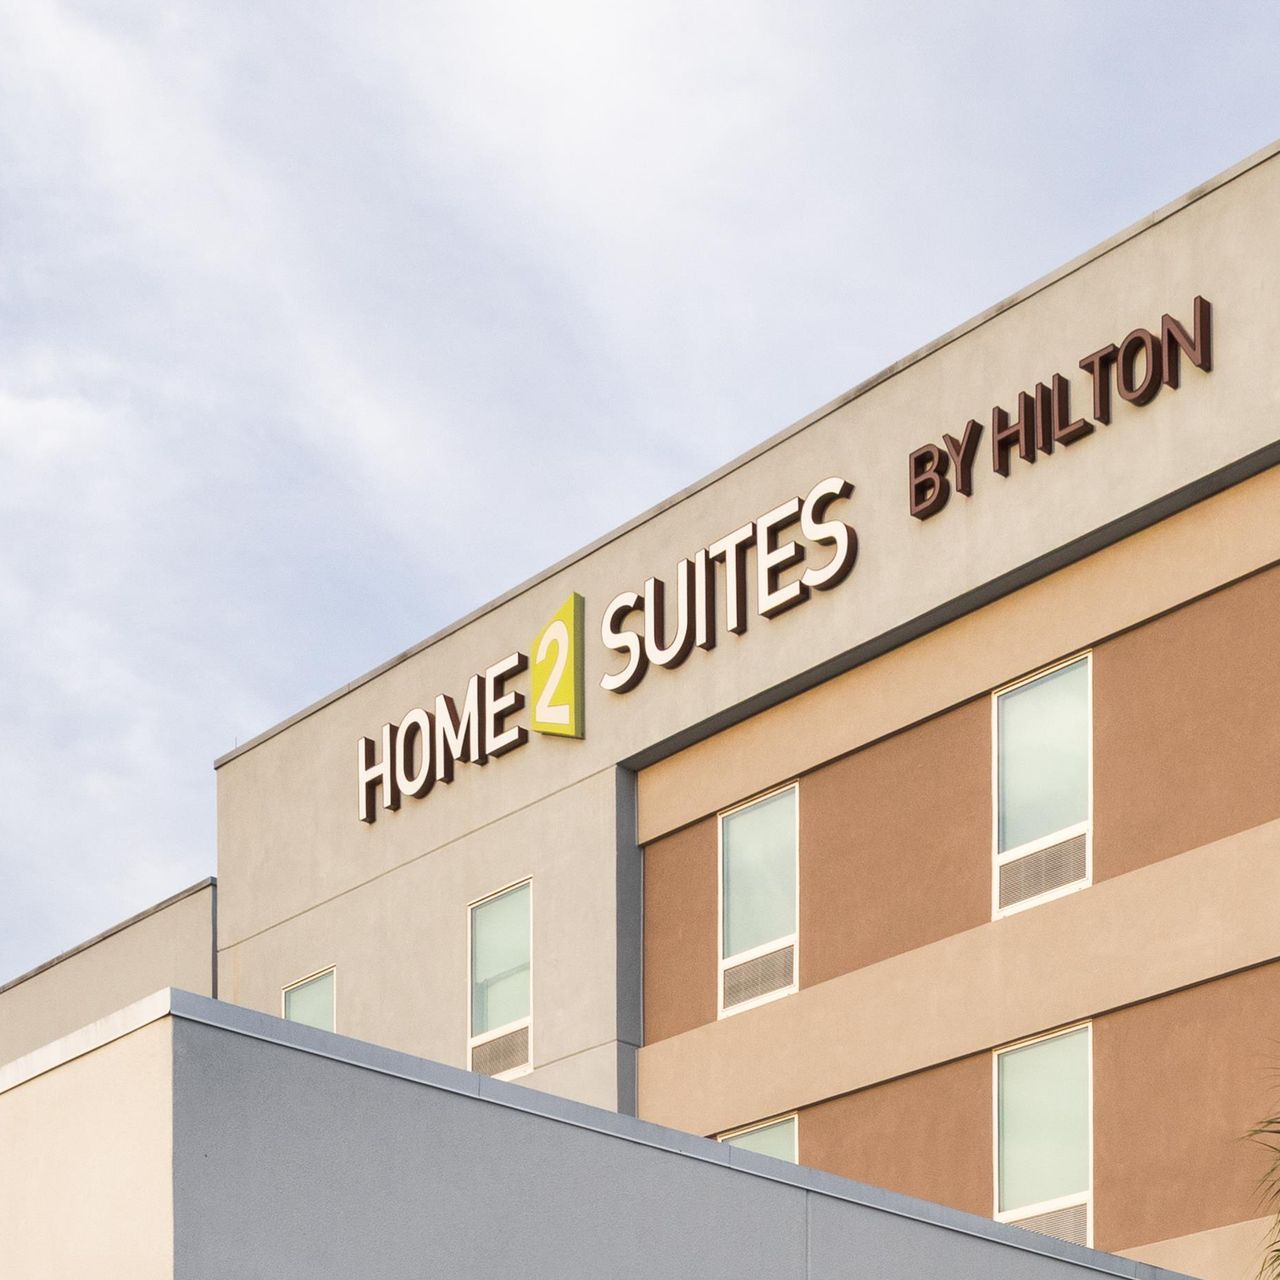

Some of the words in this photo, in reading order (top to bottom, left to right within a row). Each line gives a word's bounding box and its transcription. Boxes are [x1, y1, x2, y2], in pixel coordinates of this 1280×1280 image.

[600, 476, 858, 694] SUITES
[909, 419, 984, 521] BY
[992, 295, 1212, 478] HILTON
